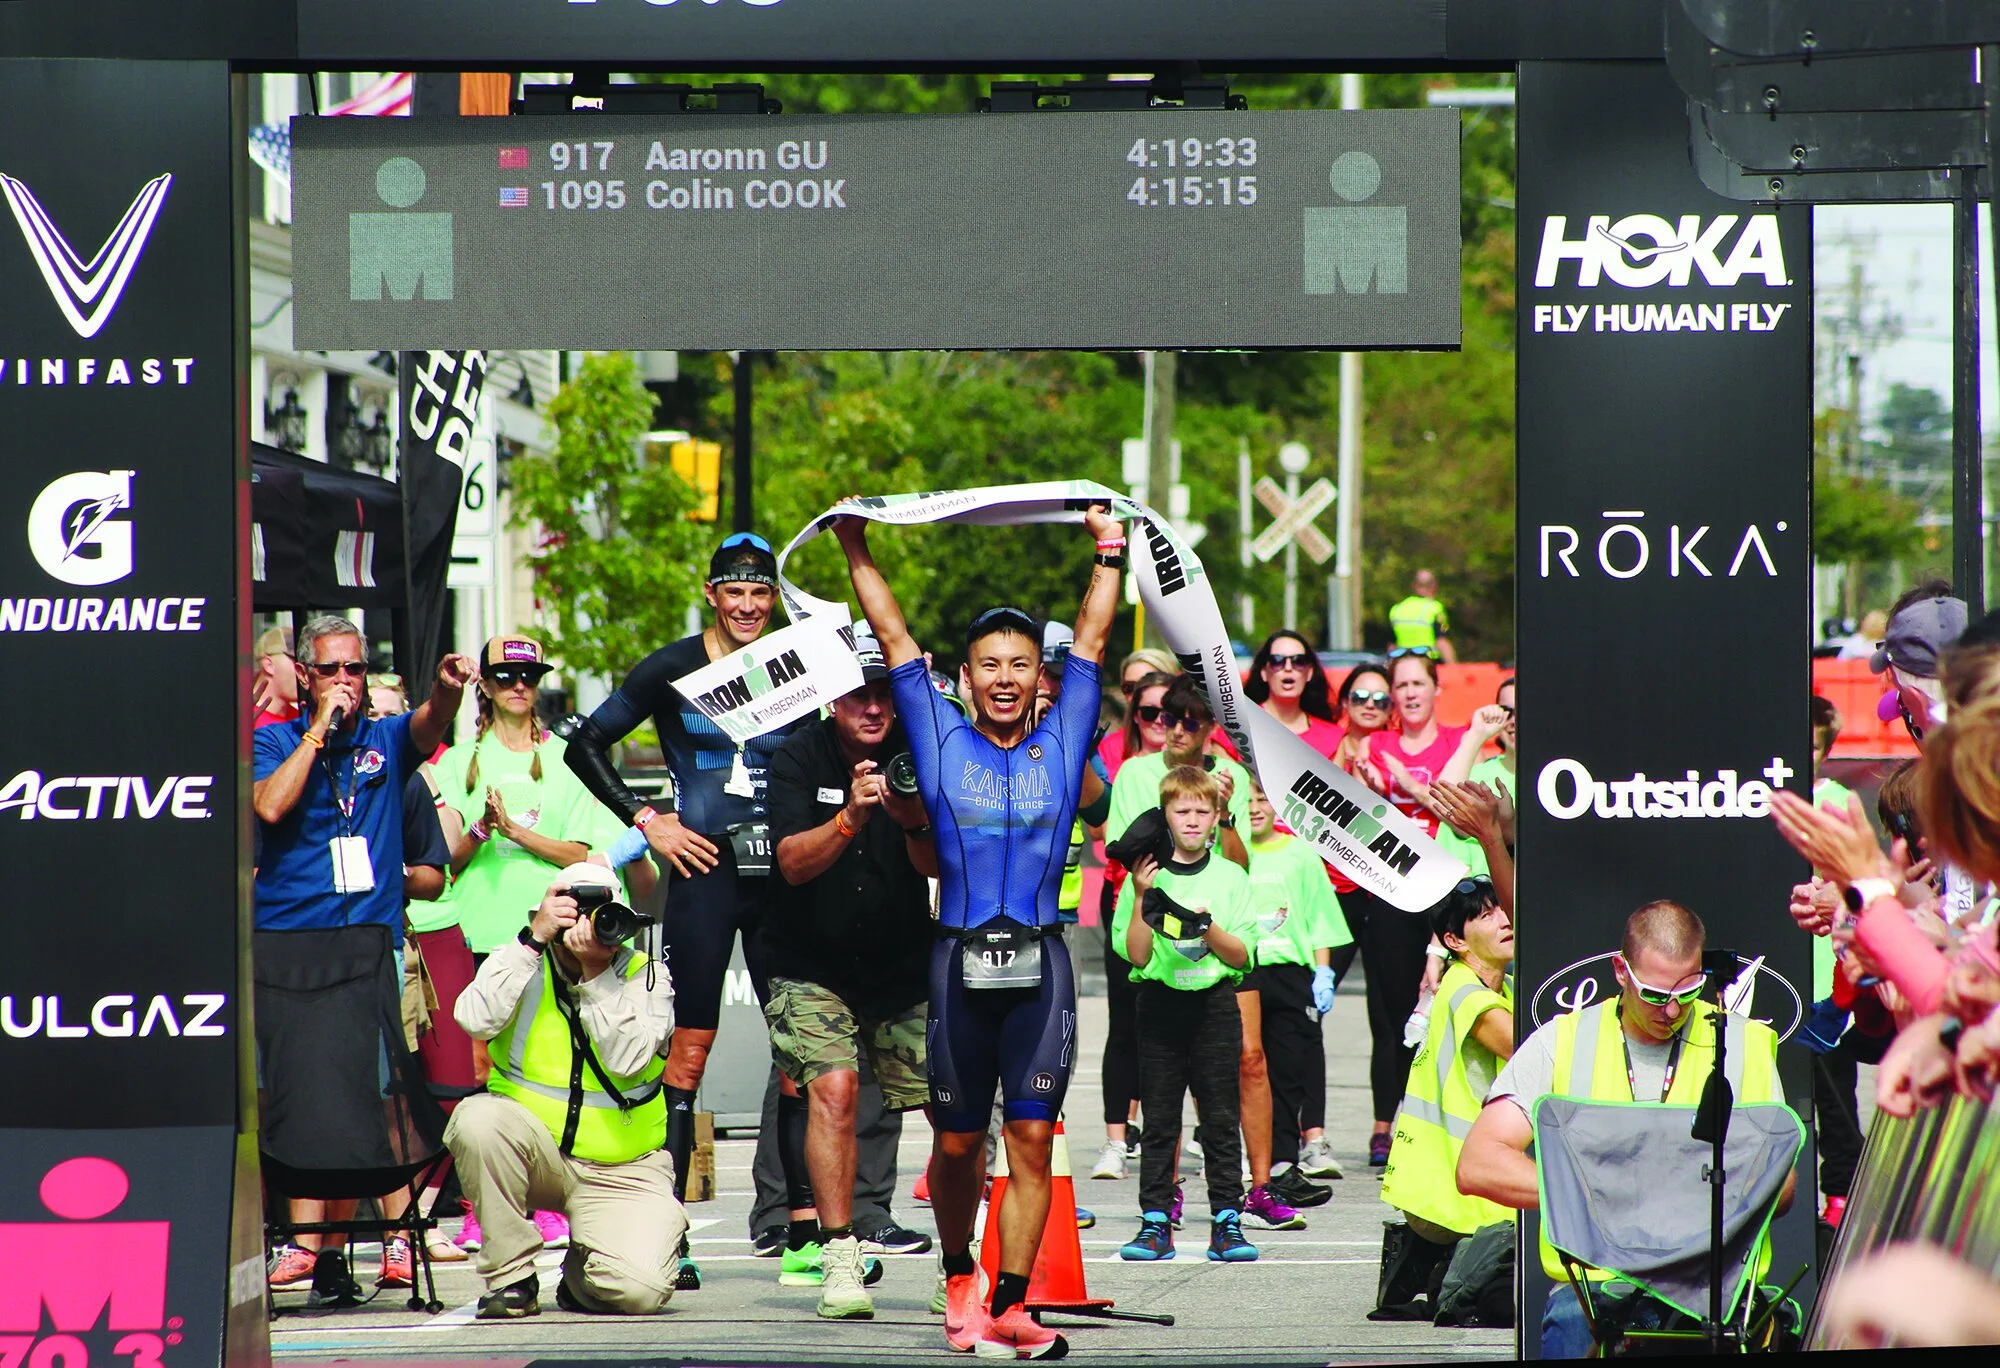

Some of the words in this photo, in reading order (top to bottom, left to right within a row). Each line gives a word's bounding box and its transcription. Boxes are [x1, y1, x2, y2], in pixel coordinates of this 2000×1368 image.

[550, 141, 614, 170] 917
[645, 141, 766, 170] Aaronn
[777, 141, 827, 169] GU
[1126, 137, 1257, 167] 4:19:33
[541, 180, 626, 209] 1095
[646, 178, 734, 209] Colin
[745, 179, 846, 208] COOK
[1126, 176, 1257, 206] 4:15:15
[1535, 213, 1793, 288] HOKA
[1534, 304, 1589, 332] FLY
[1594, 303, 1725, 332] HUMAN
[1731, 303, 1787, 332] FLY
[0, 358, 194, 385] INFAST
[888, 496, 977, 519] TIMBERMAN
[0, 597, 205, 632] NDURANCE
[692, 649, 807, 718] IRONMAN
[1212, 645, 1238, 721] TIMBERMAN
[758, 684, 818, 724] TIMBERMAN
[961, 761, 1052, 800] KARMA
[1290, 769, 1421, 877] IRONMAN
[1282, 793, 1325, 842] 70.3
[1326, 832, 1397, 894] TIMBERMAN
[982, 951, 1016, 968] 917
[1396, 1130, 1414, 1144] Pix
